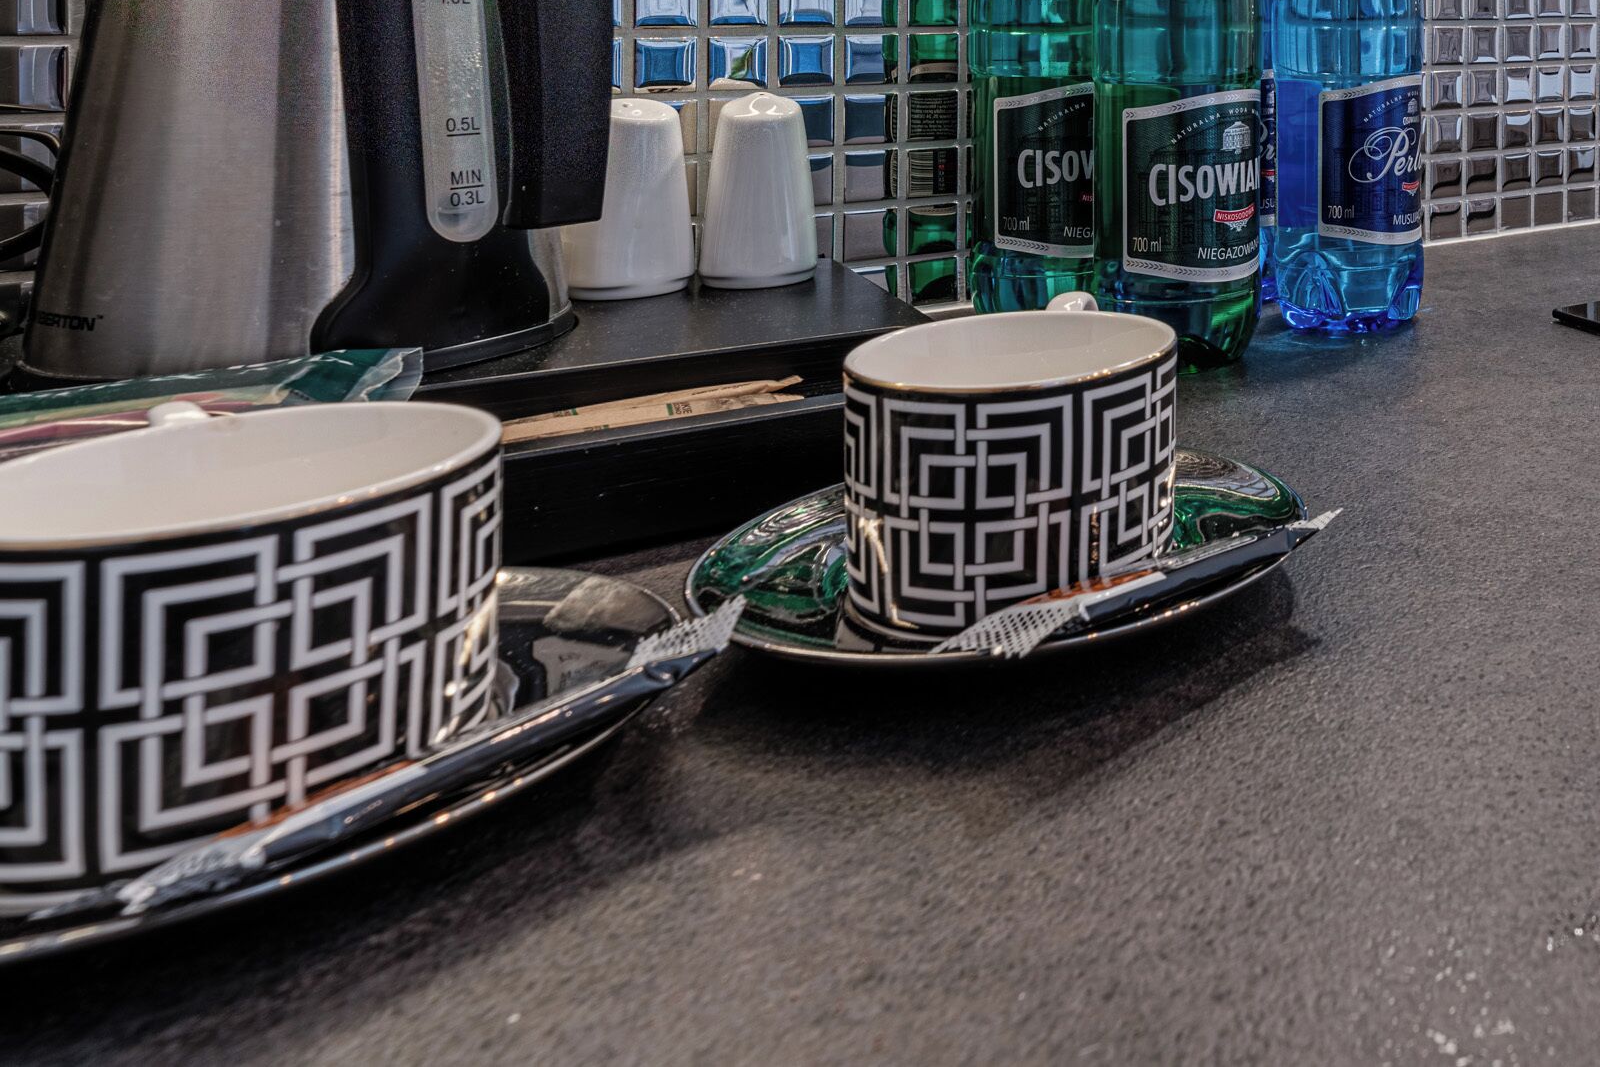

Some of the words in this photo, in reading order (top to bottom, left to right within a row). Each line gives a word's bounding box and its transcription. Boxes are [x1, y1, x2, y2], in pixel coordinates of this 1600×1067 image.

[445, 117, 480, 132] 0.5L
[1037, 101, 1086, 132] NATURALNA
[1171, 112, 1221, 145] NATURALNA
[450, 169, 481, 185] MIN
[450, 190, 485, 207] 0.3L
[1328, 205, 1343, 220] 700
[1344, 204, 1355, 220] ml
[1003, 216, 1018, 231] 700
[1019, 216, 1030, 231] ml
[1132, 236, 1149, 253] 700
[1150, 236, 1162, 252] ml
